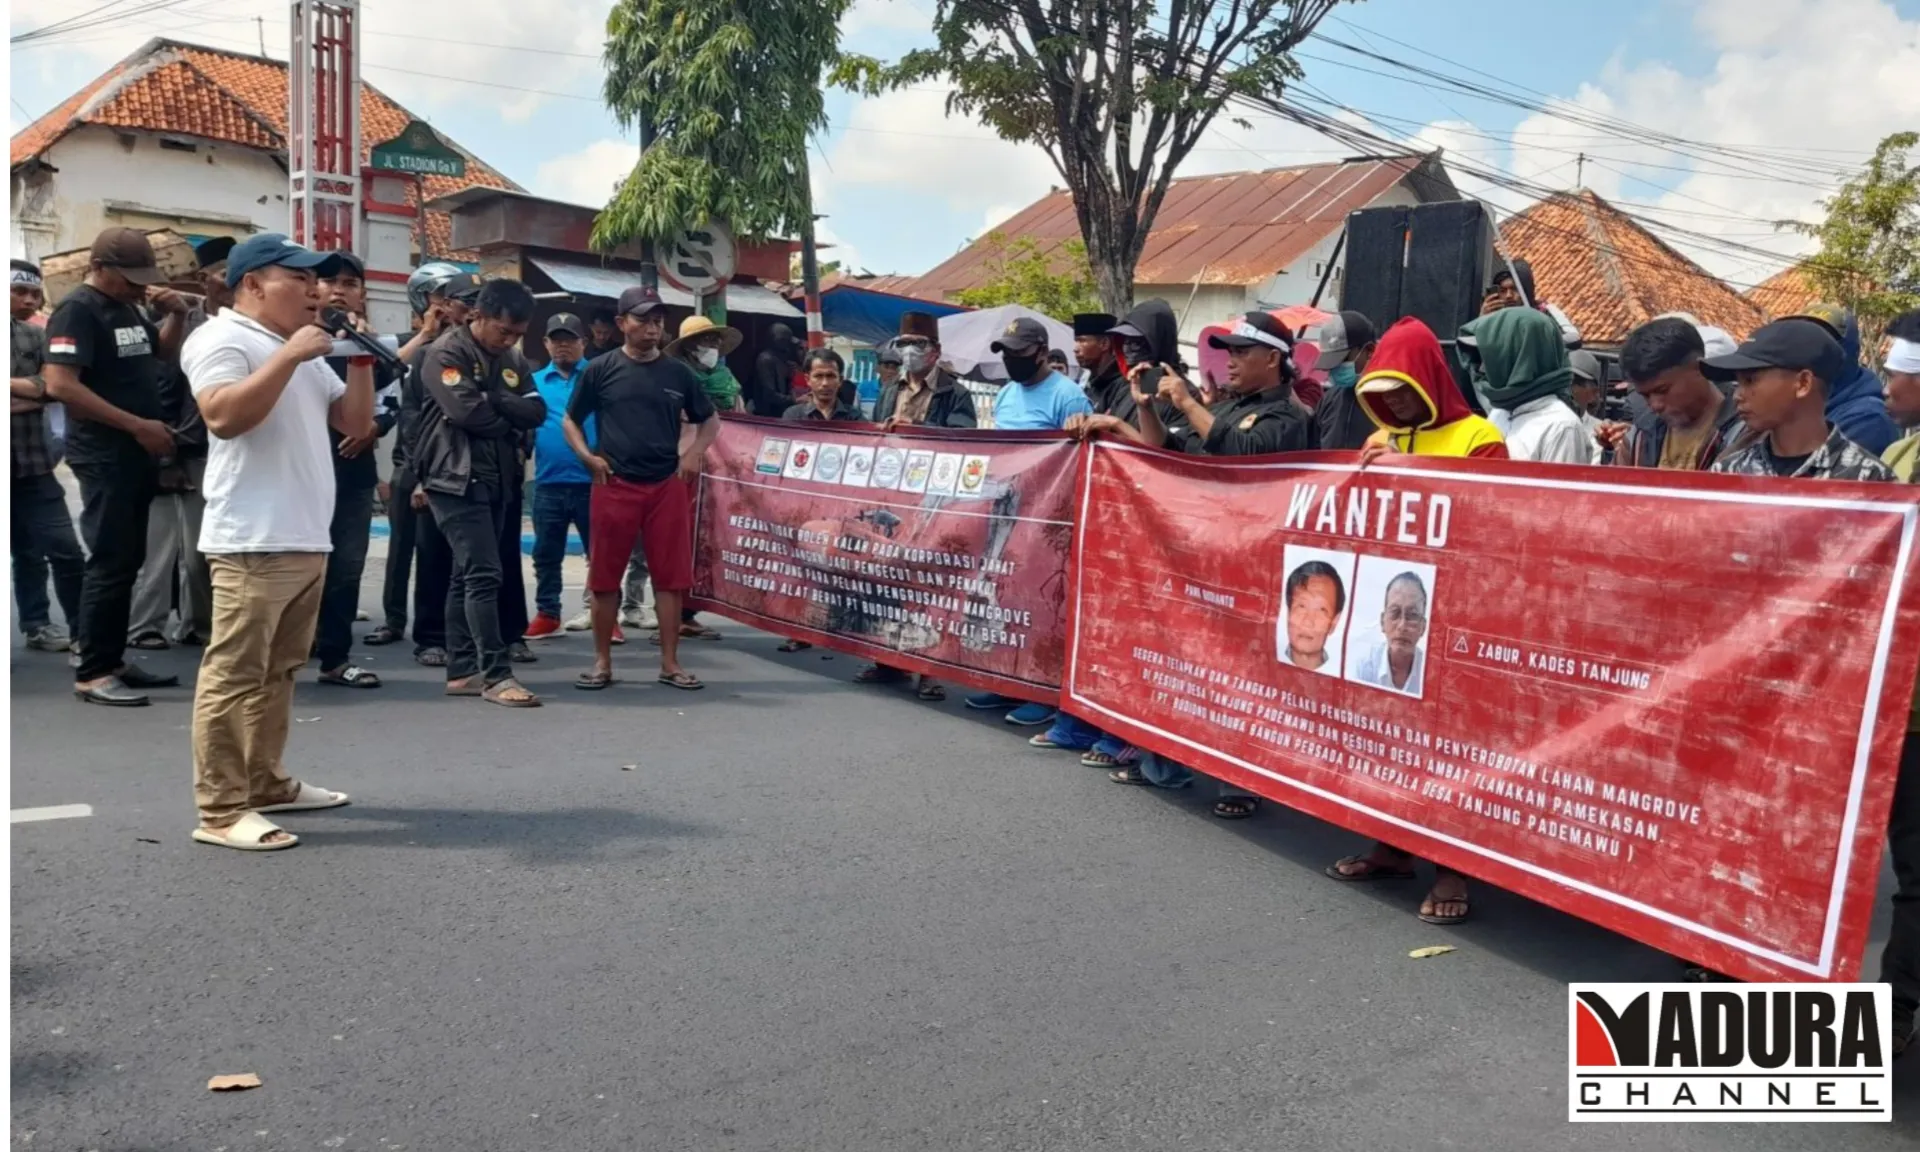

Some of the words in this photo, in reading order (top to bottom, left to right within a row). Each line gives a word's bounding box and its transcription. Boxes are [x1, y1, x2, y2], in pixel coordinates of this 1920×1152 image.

[400, 156, 436, 172] STADION
[729, 515, 768, 531] NEGARA
[798, 529, 830, 545] BOLEH
[833, 536, 868, 553] KALAH
[872, 542, 900, 558] PADA
[904, 548, 975, 569] KORPORASI
[980, 557, 1015, 576] JAHAT
[1285, 483, 1452, 548] WANTED
[722, 550, 752, 567] SEGERA
[757, 558, 803, 578] GANTUNG
[805, 568, 829, 584] PARA
[832, 575, 872, 595] PELAKU
[876, 584, 959, 612] PENGRUSAKAN
[963, 601, 1031, 626] MANGROVE
[736, 535, 788, 556] KAPOLRES
[828, 556, 850, 571] JADI
[854, 560, 910, 581] PENGECUT
[917, 570, 943, 586] DAN
[949, 575, 997, 596] PENAKUT
[742, 574, 775, 591] SEMUA
[780, 582, 808, 598] ALAT
[812, 588, 842, 607] BERAT
[846, 597, 857, 611] PT
[862, 600, 908, 622] BUDIONO
[937, 617, 944, 631] 5
[948, 620, 976, 638] ALAT
[982, 627, 1026, 649] BERAT
[1478, 642, 1523, 667] ZABUR,
[1528, 652, 1576, 676] KADES
[1581, 662, 1650, 690] TANJUNG
[1133, 646, 1163, 665] SEGERA
[1166, 656, 1206, 679] TETAPKAN
[1208, 670, 1230, 686] DAN
[1232, 676, 1278, 700] TANGKAP
[1281, 690, 1317, 714] PELAKU
[1320, 704, 1400, 739] PENGRUSAKAN
[1406, 728, 1430, 748] DAN
[1436, 736, 1537, 780] PENYEROBOTAN
[1542, 767, 1595, 796] LAHAN
[1602, 783, 1701, 826] MANGROVE
[1153, 671, 1186, 691] PESISIR
[1186, 682, 1206, 699] DESA
[1209, 690, 1254, 714] TANJUNG
[1256, 704, 1315, 734] PADEMAWU
[1318, 724, 1338, 742] DAN
[1342, 732, 1386, 757] PESISIR
[1390, 746, 1420, 769] DESA
[1426, 758, 1470, 783] AMBAT
[1472, 773, 1546, 808] TLANAKAN
[1173, 697, 1207, 720] BUDIONO
[1209, 709, 1246, 733] MADURA
[1250, 723, 1292, 748] BANGUN
[1294, 738, 1344, 765] PERSADA
[1348, 755, 1370, 775] DAN
[1373, 764, 1418, 792] KEPALA
[1422, 780, 1452, 805] DESA
[1458, 792, 1521, 826] TANJUNG
[1528, 814, 1620, 857] PADEMAWU
